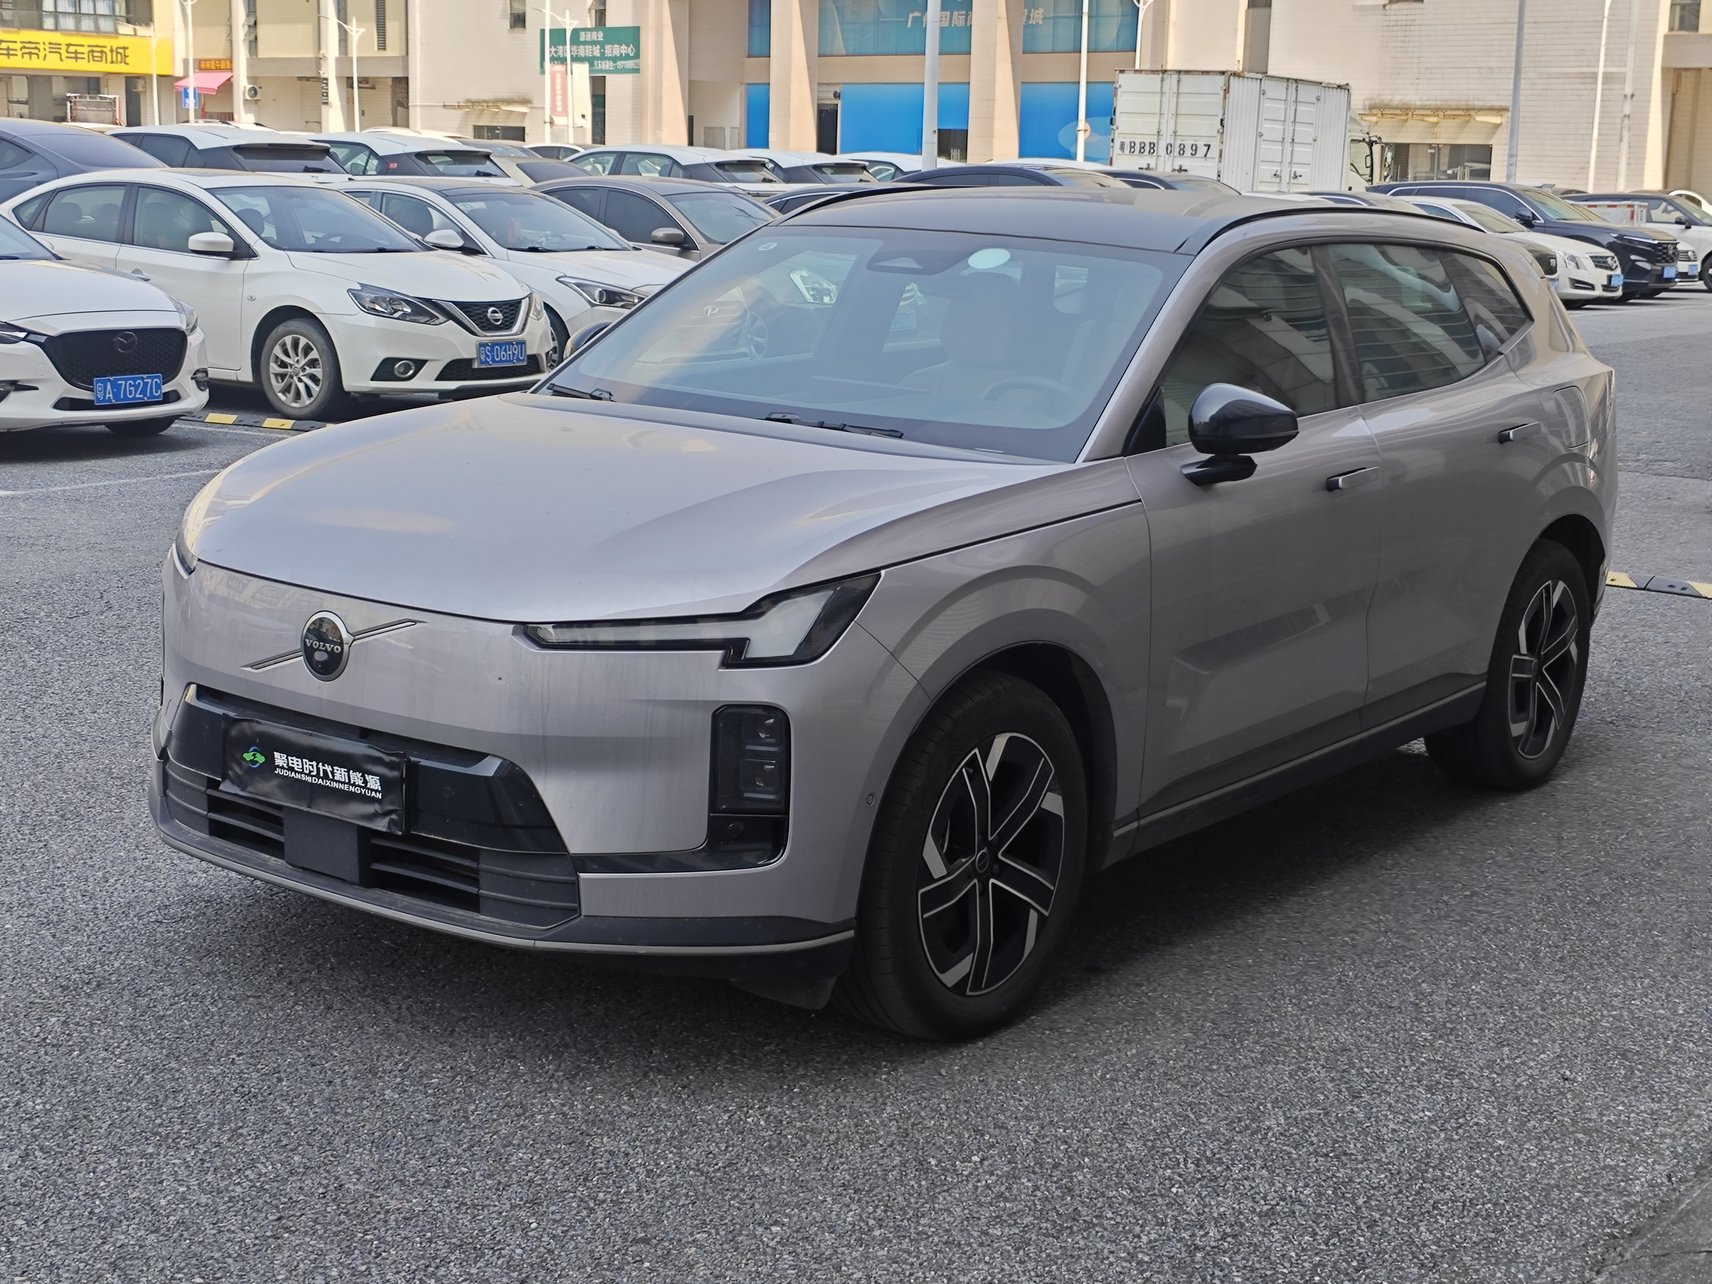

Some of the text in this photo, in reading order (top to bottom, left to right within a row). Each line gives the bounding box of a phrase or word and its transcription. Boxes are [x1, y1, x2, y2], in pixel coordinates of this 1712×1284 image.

[305, 638, 342, 653] VOLVO
[273, 751, 382, 791] 聚电时代新能源
[274, 767, 382, 800] JUDIANSHIDAIXINNENGYUAN
